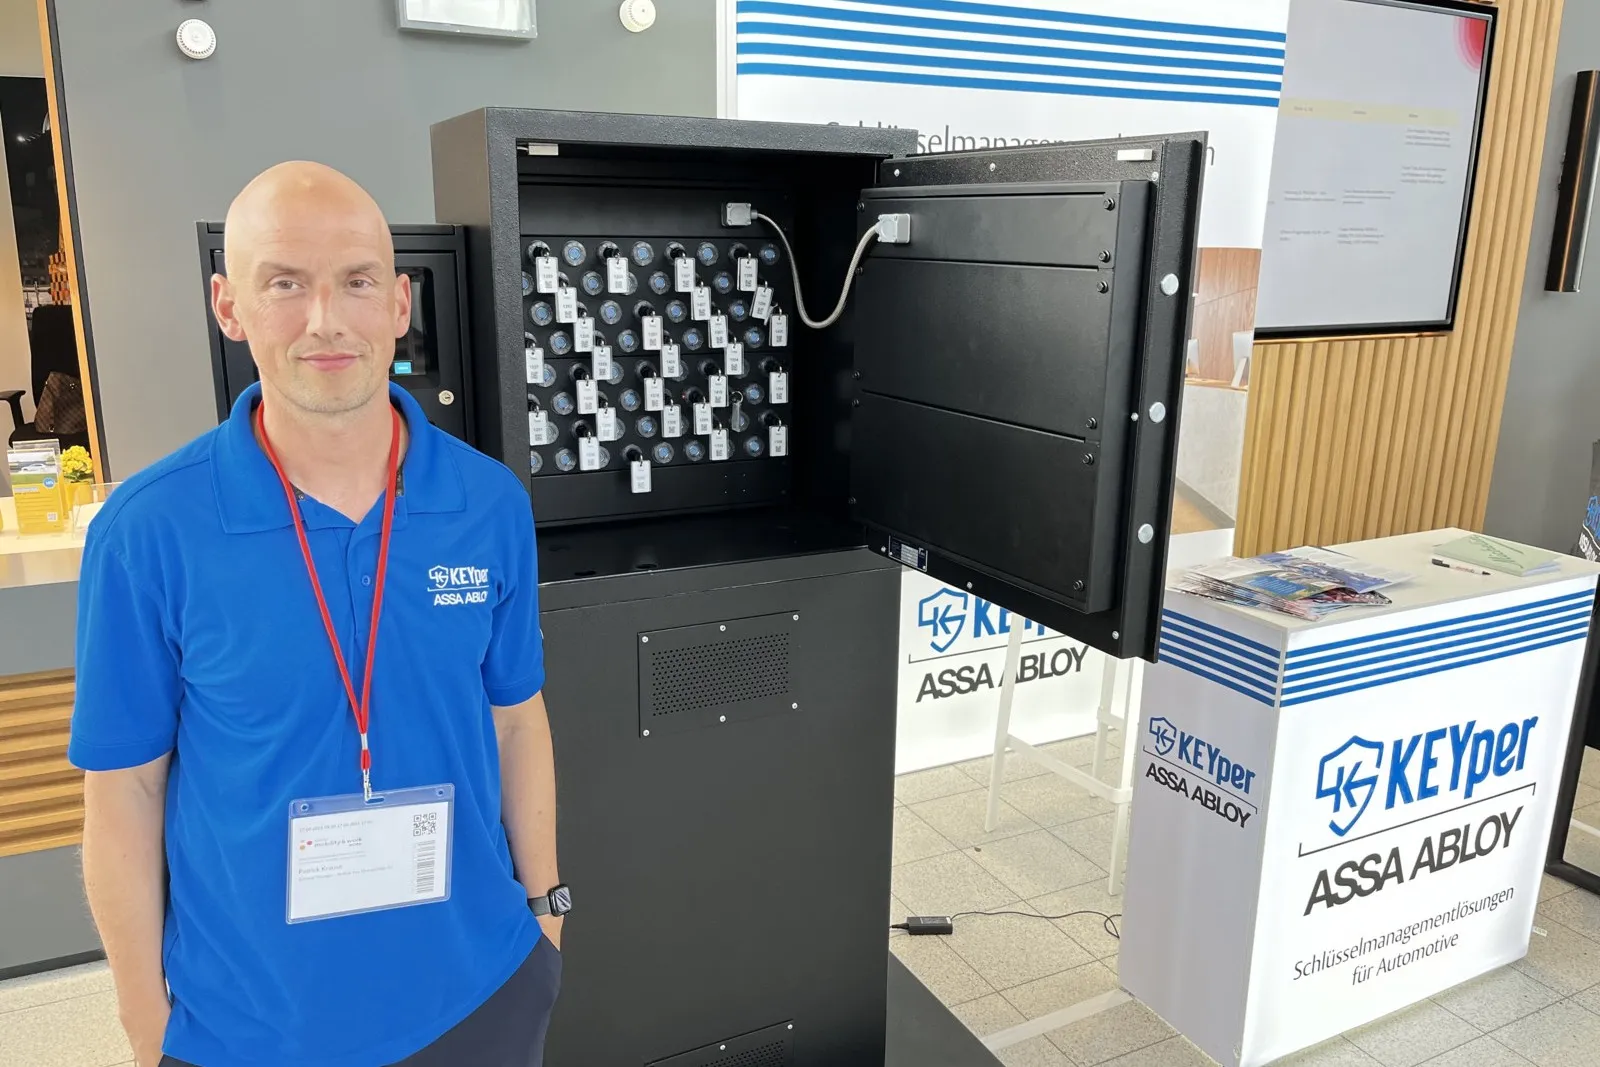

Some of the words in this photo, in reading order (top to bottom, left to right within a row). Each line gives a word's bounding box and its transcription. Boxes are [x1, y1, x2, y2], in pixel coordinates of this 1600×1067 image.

[433, 593, 464, 606] ASSA
[915, 663, 994, 703] ASSA
[1178, 731, 1256, 794] KEYper
[1385, 716, 1539, 810] KEYper
[1145, 762, 1189, 798] ASSA
[1191, 785, 1251, 828] ABLOY
[1303, 846, 1404, 916] ASSA
[1409, 805, 1524, 881] ABLOY
[1293, 887, 1514, 980] Schlüsselmanagementlösungen
[1352, 964, 1373, 985] für
[1376, 932, 1459, 976] Automotive
